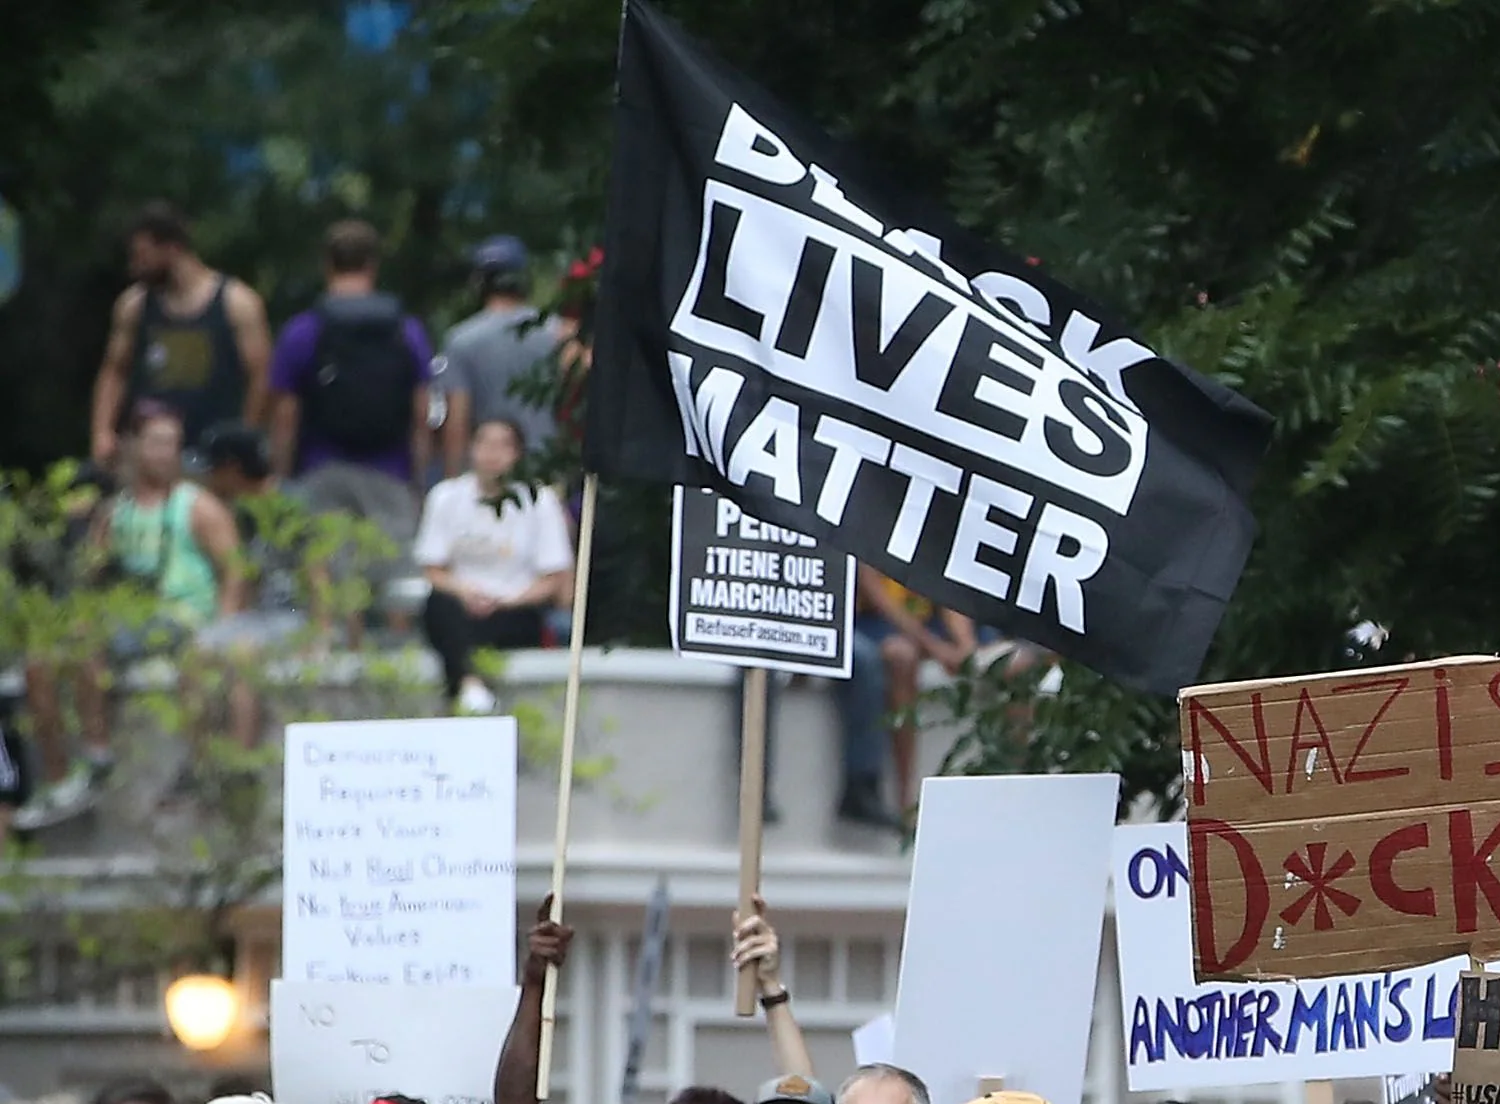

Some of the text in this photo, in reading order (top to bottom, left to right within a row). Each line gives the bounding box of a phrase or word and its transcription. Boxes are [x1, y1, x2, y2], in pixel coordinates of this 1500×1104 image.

[691, 201, 1134, 477] LIVES
[667, 350, 1109, 635] MATTER
[690, 577, 834, 621] MARCHARSE!
[783, 554, 824, 587] QUE
[695, 617, 828, 651] RefuseFascism.org
[1130, 989, 1284, 1065] ANOTHER
[1284, 972, 1413, 1054] MAN'S
